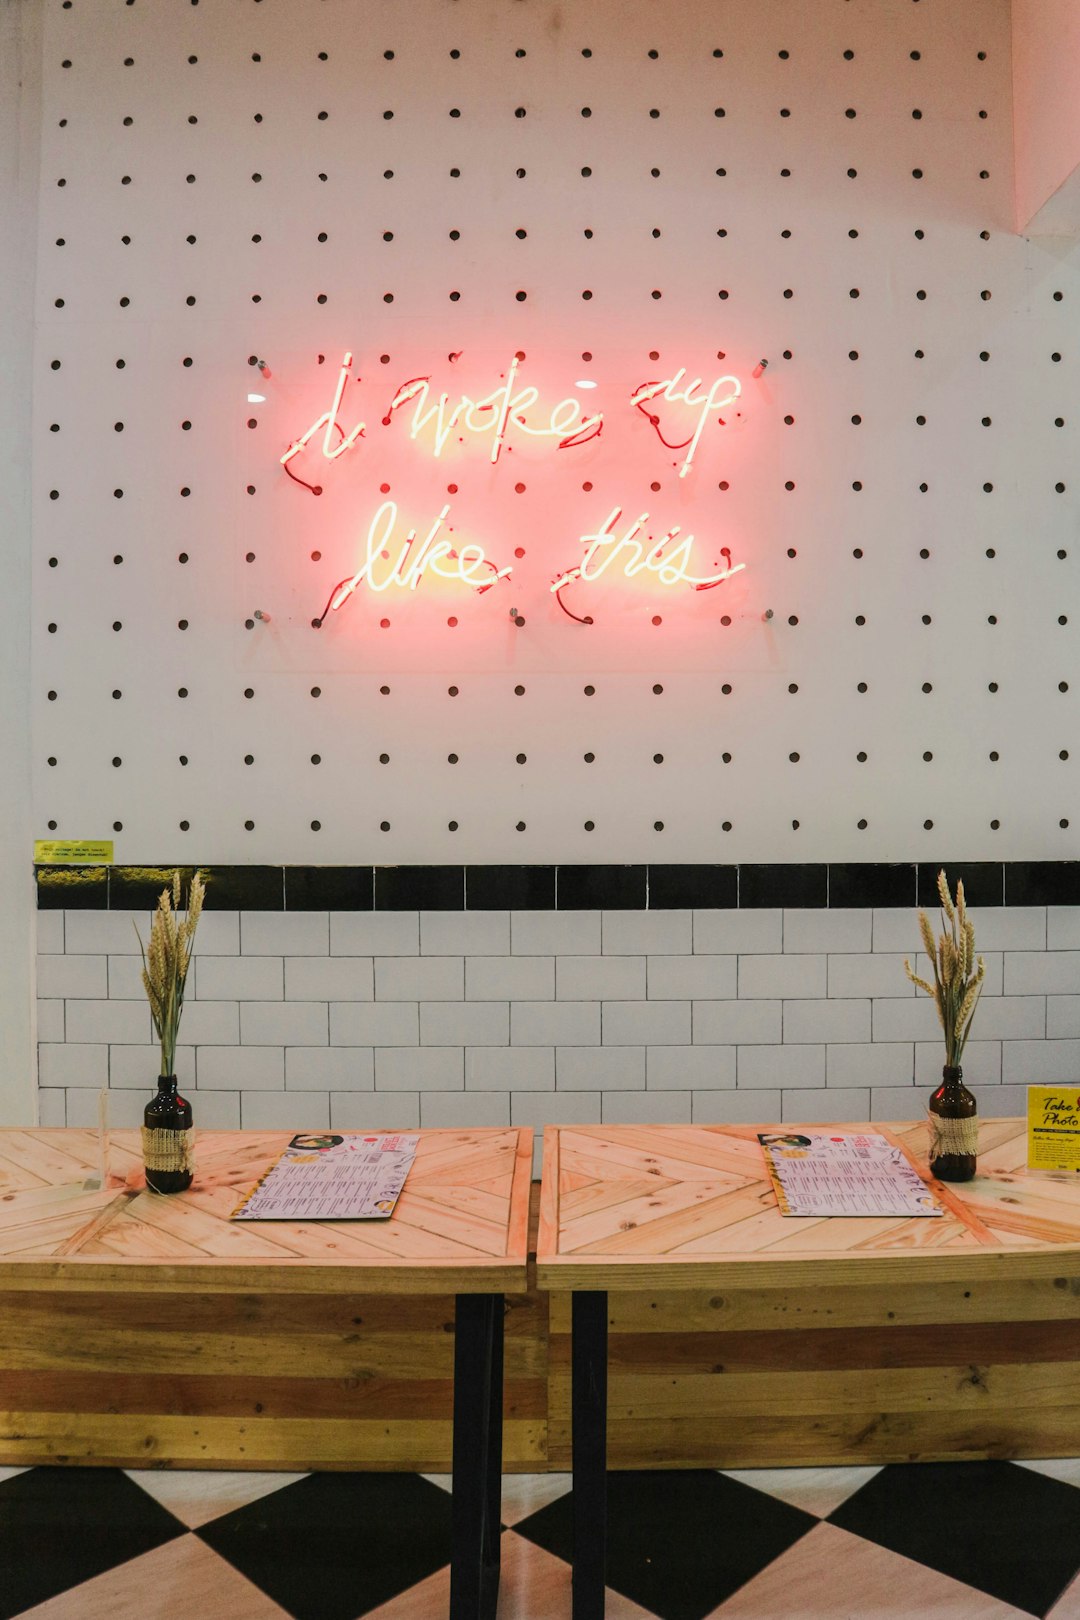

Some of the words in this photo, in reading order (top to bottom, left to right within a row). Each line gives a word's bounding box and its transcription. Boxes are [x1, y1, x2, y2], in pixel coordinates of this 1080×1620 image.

[280, 352, 366, 463] I
[392, 357, 603, 463] woke
[630, 368, 742, 478] up
[332, 501, 513, 609] like
[550, 506, 746, 593] this
[1042, 1112, 1078, 1126] Photo
[1043, 1097, 1073, 1111] Take
